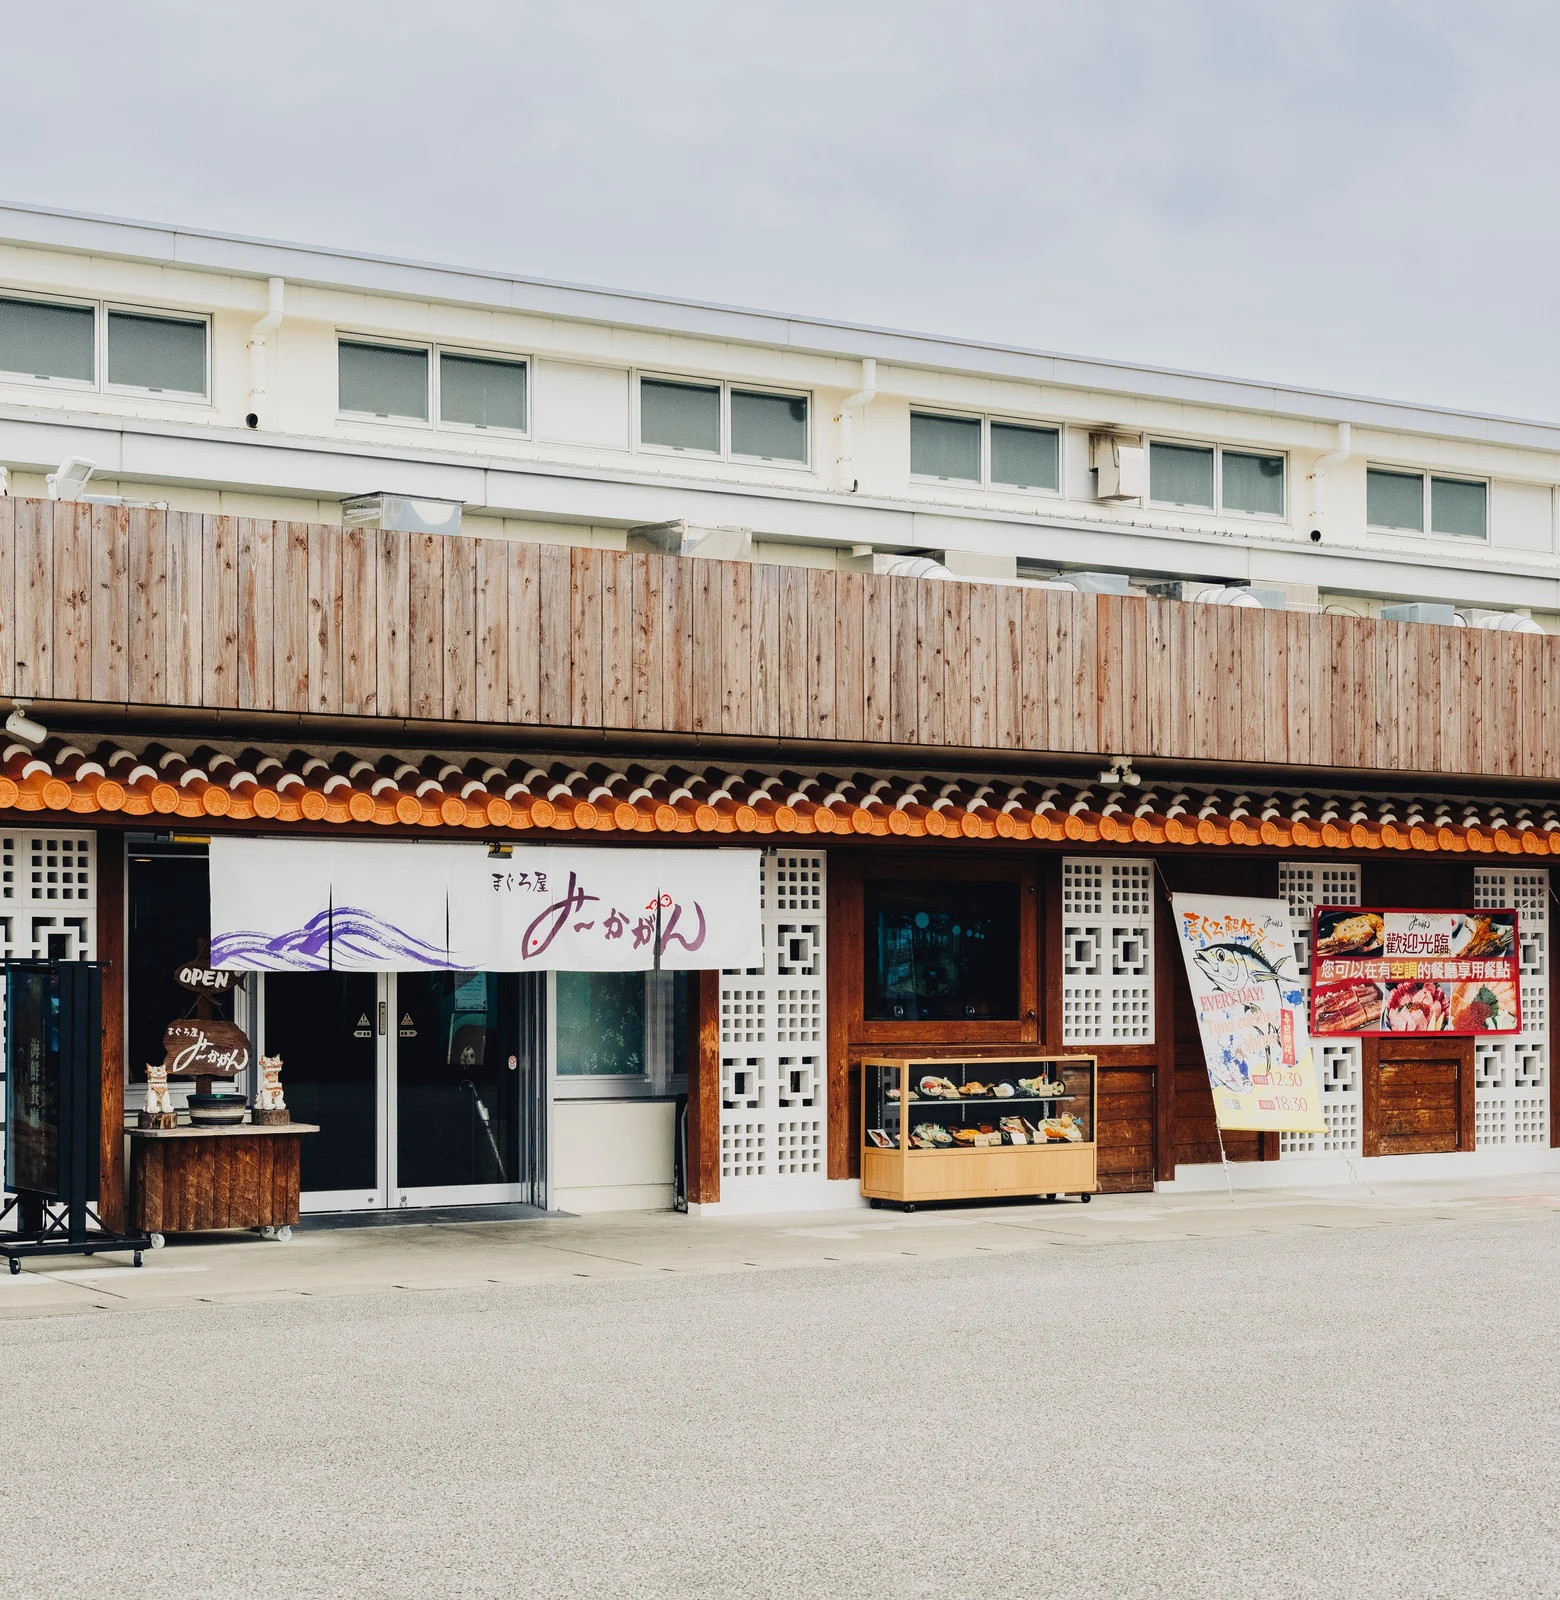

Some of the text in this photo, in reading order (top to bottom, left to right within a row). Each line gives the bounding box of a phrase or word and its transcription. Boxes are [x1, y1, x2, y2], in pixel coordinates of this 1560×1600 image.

[491, 871, 549, 892] まぐろ屋
[1386, 932, 1450, 955] 歡迎光臨
[180, 967, 229, 988] OPEN
[1321, 959, 1511, 980] 您可以在有空調的餐廳享用餐點
[1199, 987, 1265, 1012] EVERY DAY!
[168, 1027, 199, 1038] まぐろ屋
[1269, 1071, 1302, 1087] 12:30
[1274, 1096, 1308, 1112] 18:30
